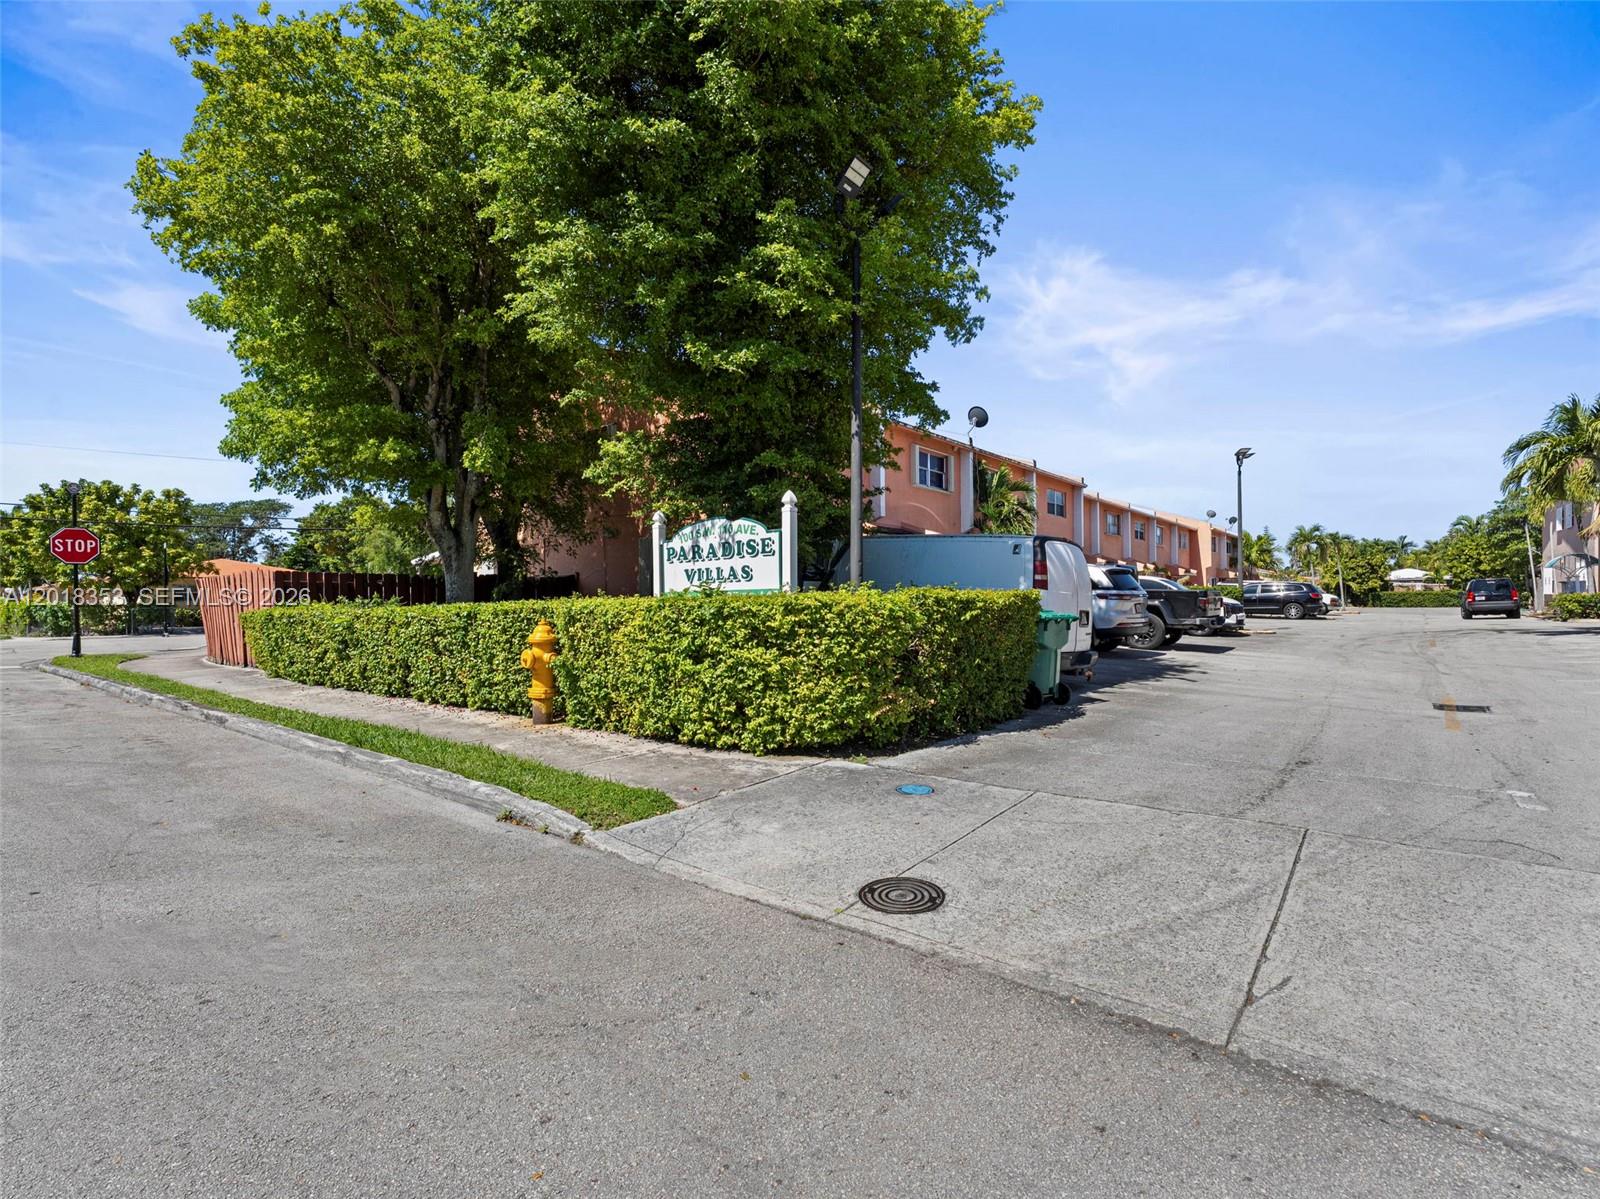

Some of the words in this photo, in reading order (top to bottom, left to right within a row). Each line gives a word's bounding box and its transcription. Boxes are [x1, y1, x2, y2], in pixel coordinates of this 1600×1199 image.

[735, 523, 759, 536] AVE.
[54, 538, 96, 553] STOP
[666, 537, 776, 564] PARADISE
[684, 565, 753, 584] VILLAS
